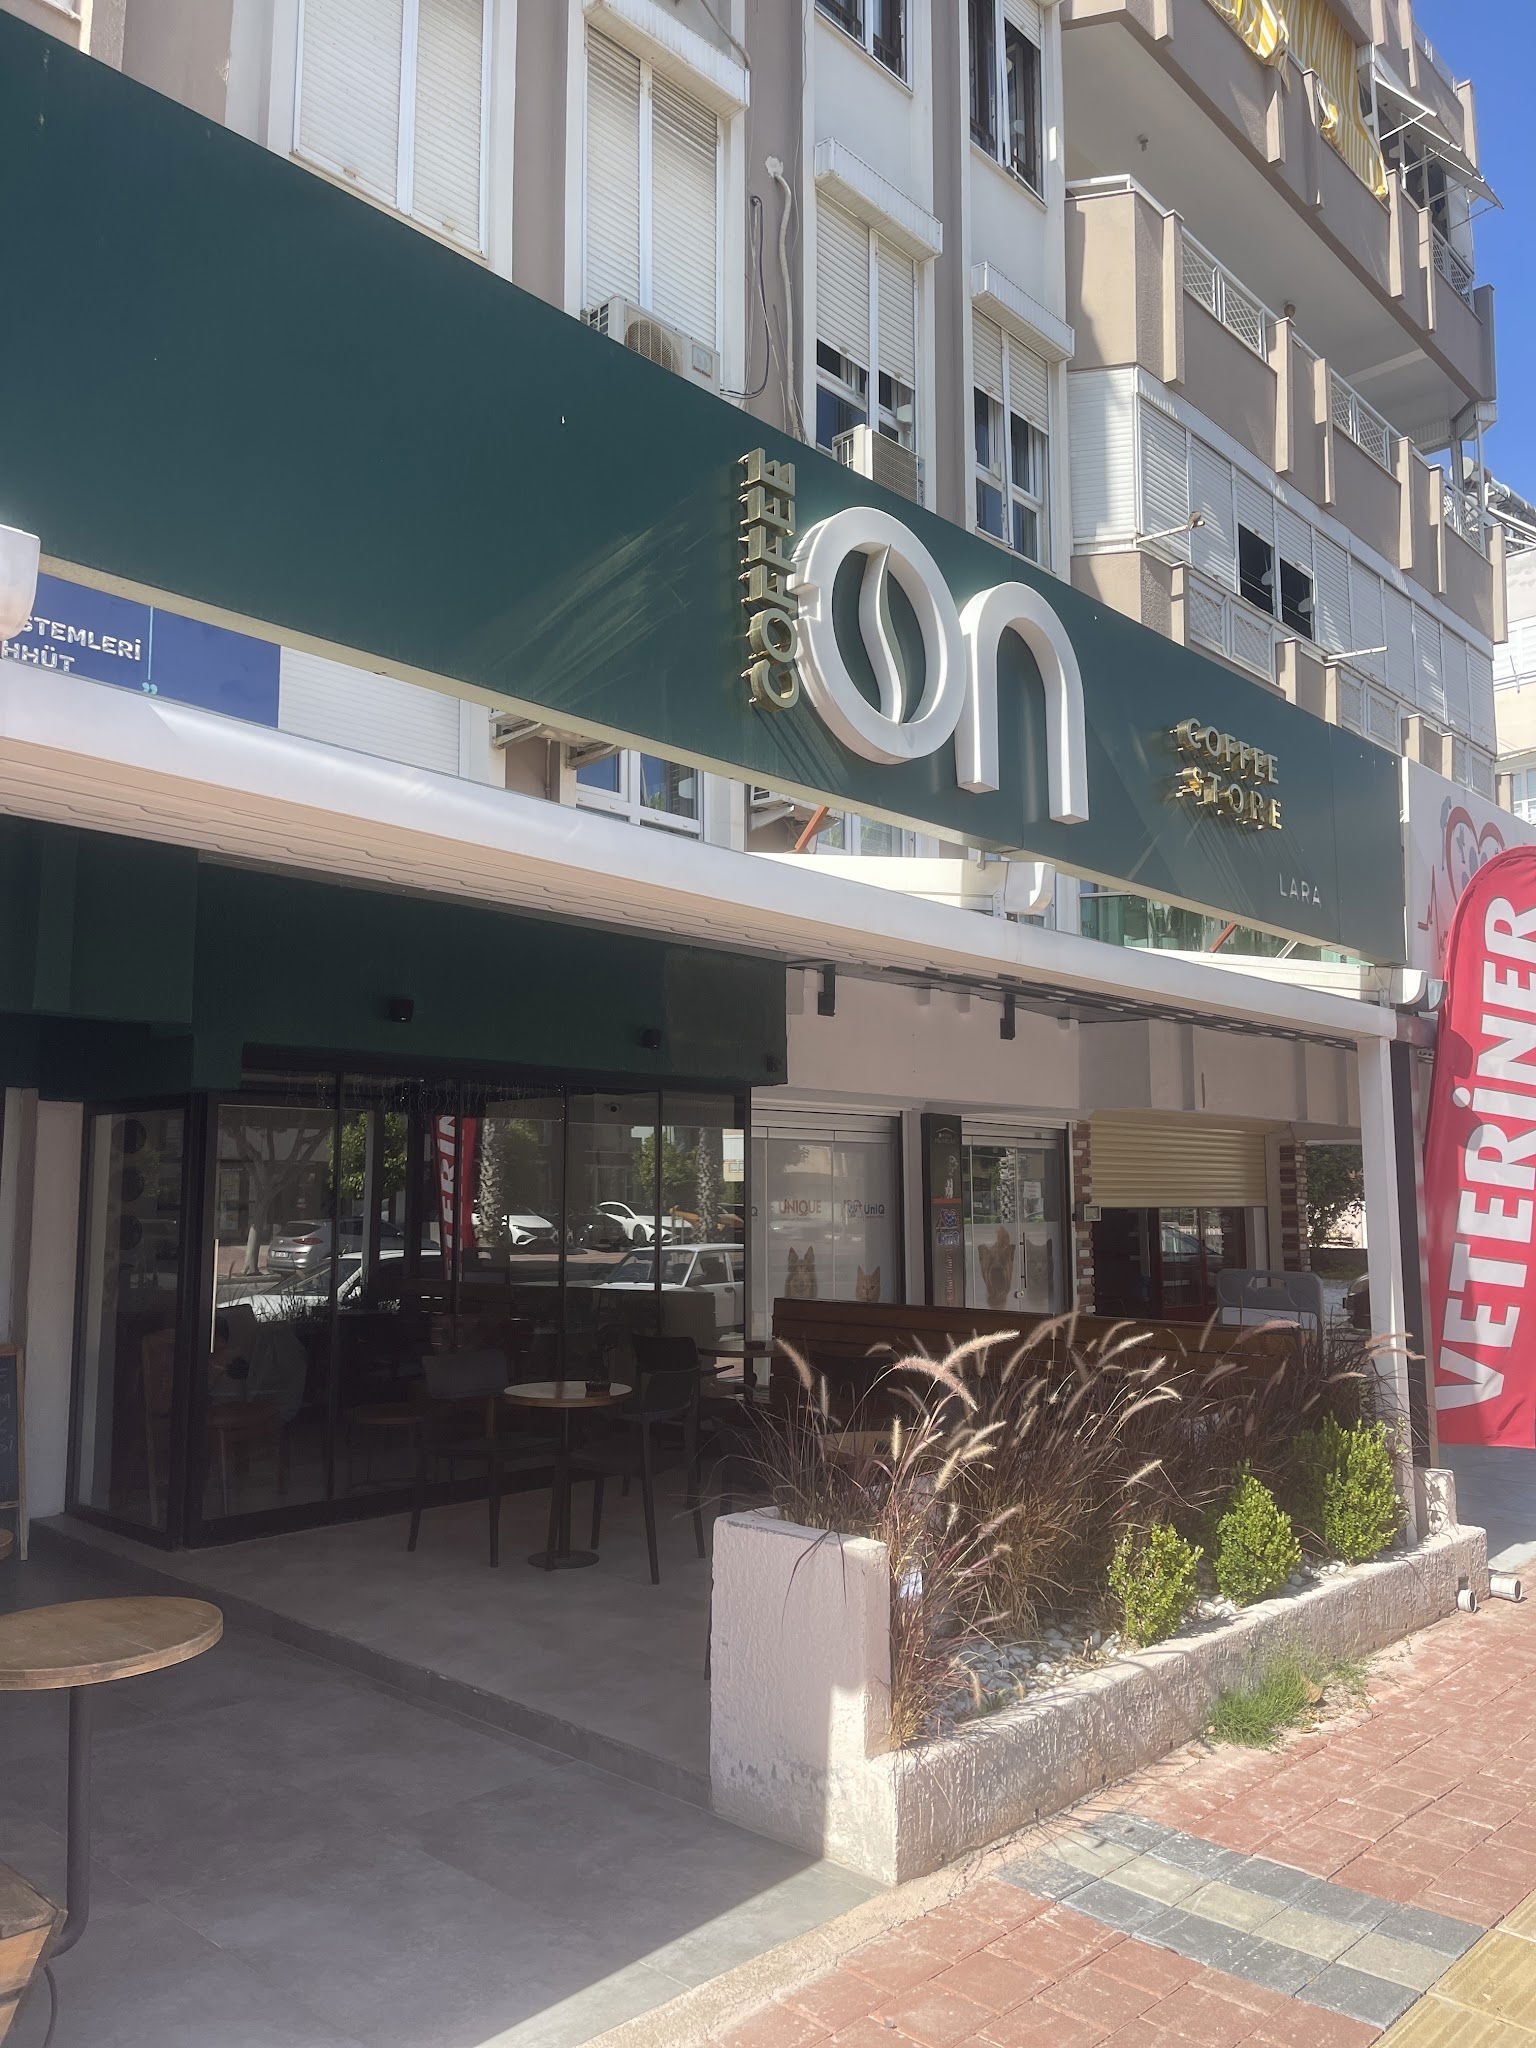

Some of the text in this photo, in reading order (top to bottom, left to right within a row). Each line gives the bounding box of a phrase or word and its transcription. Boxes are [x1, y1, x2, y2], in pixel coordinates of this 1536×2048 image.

[745, 447, 802, 712] COFFEE
[1177, 717, 1280, 785] COFFEE
[1178, 765, 1283, 829] STORE
[1279, 872, 1322, 908] LARA
